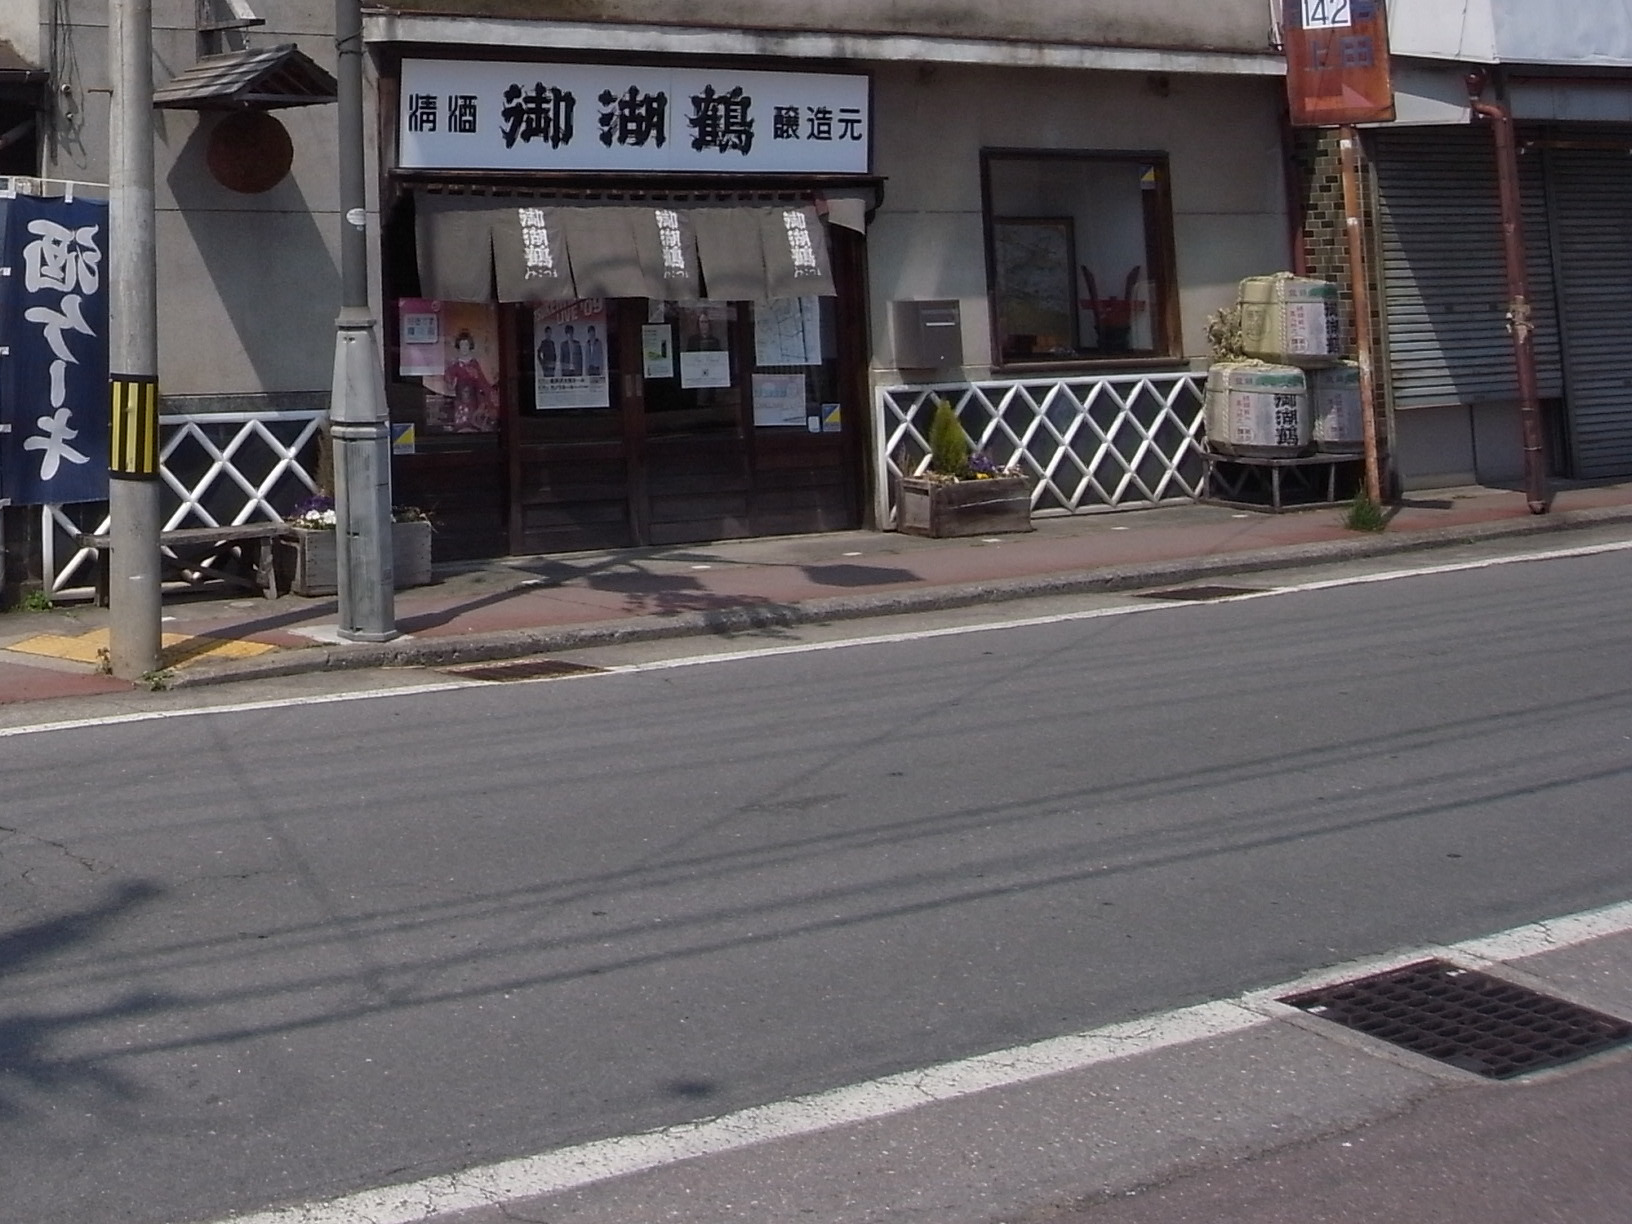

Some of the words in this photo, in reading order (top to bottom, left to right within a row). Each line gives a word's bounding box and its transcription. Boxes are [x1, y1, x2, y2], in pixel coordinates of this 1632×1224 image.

[408, 93, 478, 134] 清酒
[500, 81, 755, 156] 御湖鶴
[772, 105, 863, 142] 醸造元
[518, 207, 553, 269] 御湖鶴
[1273, 393, 1299, 446] 御湖鶴
